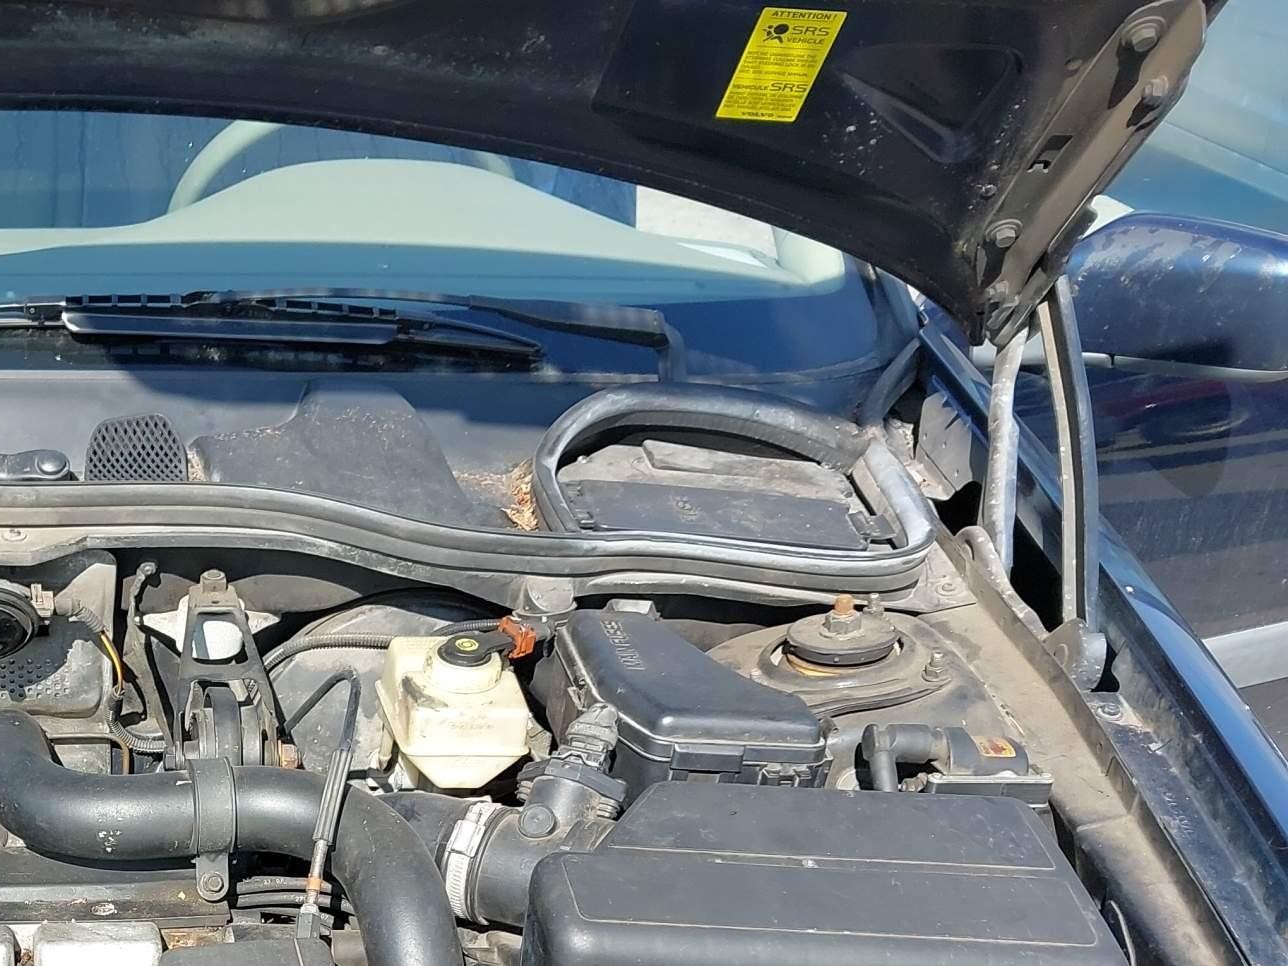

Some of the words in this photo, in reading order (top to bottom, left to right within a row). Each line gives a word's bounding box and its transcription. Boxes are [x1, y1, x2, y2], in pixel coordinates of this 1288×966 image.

[771, 10, 831, 20] ATTENTION
[791, 25, 832, 37] SRS
[787, 37, 825, 45] VEHICLE
[770, 82, 809, 93] SRS
